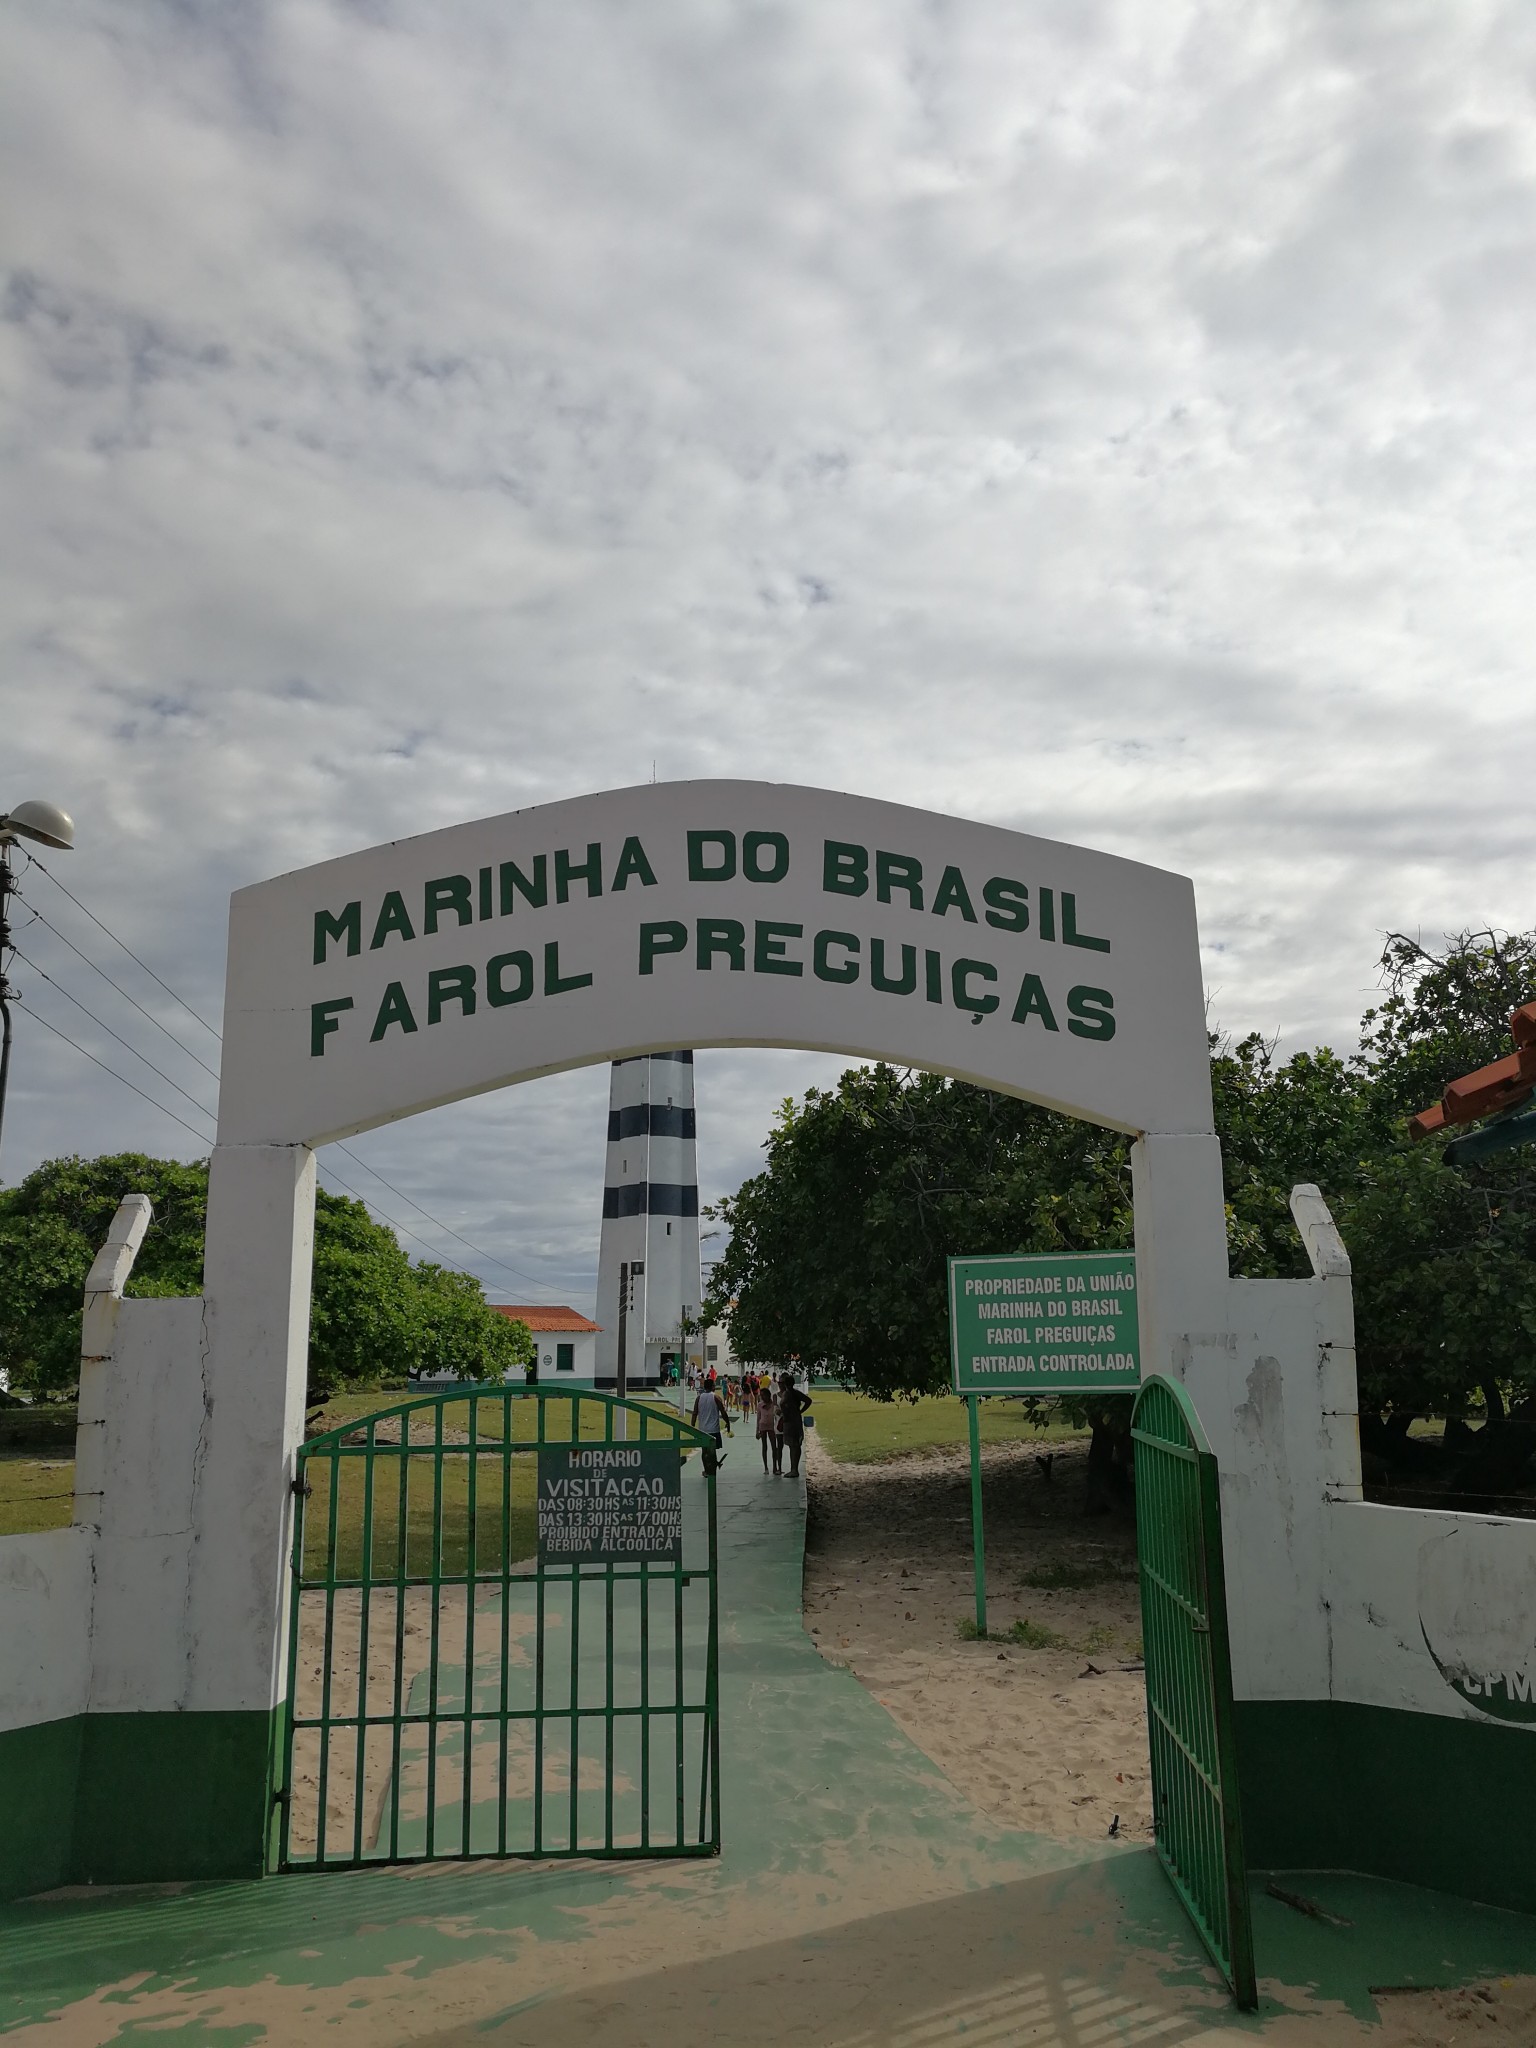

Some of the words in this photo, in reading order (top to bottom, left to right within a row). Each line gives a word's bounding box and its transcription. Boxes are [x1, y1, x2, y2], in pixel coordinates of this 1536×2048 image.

[314, 836, 658, 965] MARINHA
[687, 830, 789, 883] DO
[823, 839, 1110, 953] BRASIL
[311, 941, 593, 1057] FAROL
[639, 918, 1116, 1041] PREGUIÇAS
[965, 1277, 1062, 1296] PROPRIEDADE
[1066, 1276, 1086, 1293] DA
[1089, 1271, 1135, 1291] UNIÃO
[978, 1301, 1044, 1320] MARINHA
[1047, 1301, 1067, 1317] DO
[1072, 1299, 1123, 1317] BRASIL
[987, 1327, 1031, 1345] FAROL
[1035, 1325, 1116, 1346] PREGUIÇAS
[972, 1356, 1036, 1373] ENTRADA
[1039, 1353, 1135, 1372] CONTROLADA
[568, 1449, 642, 1468] HORÁRIO
[593, 1469, 607, 1479] DE
[546, 1475, 664, 1497] VISITAÇÃO
[538, 1498, 565, 1511] DAS
[622, 1498, 635, 1506] AS
[538, 1513, 565, 1527] DAS
[620, 1513, 633, 1521] AS
[539, 1526, 599, 1540] PROIBIDO
[602, 1526, 665, 1539] ENTRADA
[668, 1526, 681, 1538] DE
[546, 1539, 592, 1552] BEBIDA
